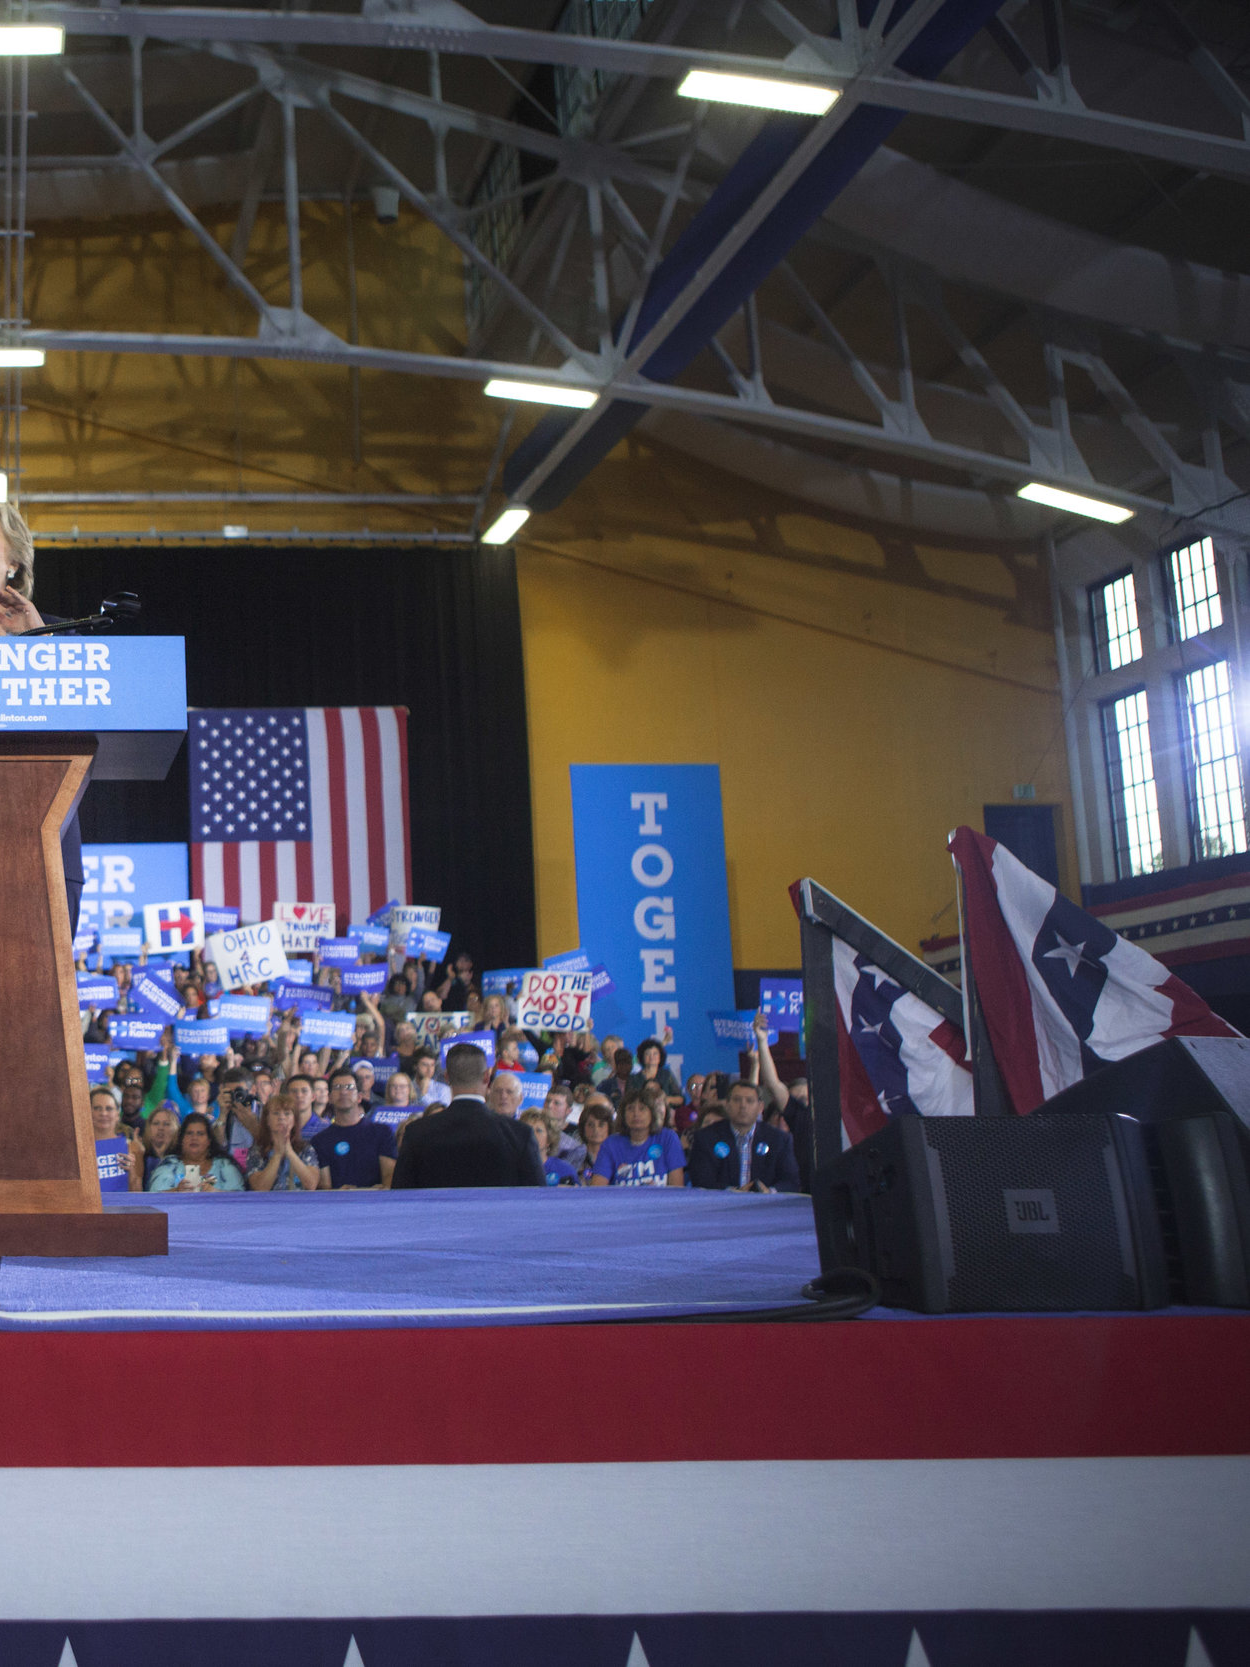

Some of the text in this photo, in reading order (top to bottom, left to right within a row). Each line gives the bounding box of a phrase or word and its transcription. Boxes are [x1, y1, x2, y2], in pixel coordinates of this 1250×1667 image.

[286, 922, 329, 932] TRUMPS
[223, 925, 271, 952] OHIO
[630, 793, 685, 1085] TOGET
[228, 957, 273, 985] HRC
[530, 974, 558, 993] DO
[559, 974, 591, 991] THE
[523, 993, 588, 1014] MOST
[523, 1011, 585, 1031] GOOD
[130, 1022, 163, 1031] Clinton
[129, 1030, 156, 1038] Kaine
[177, 1027, 227, 1036] STRONGER
[84, 1053, 108, 1062] inton
[86, 1062, 101, 1071] ine
[523, 1082, 549, 1090] NGER
[524, 1090, 549, 1099] THER
[375, 1110, 412, 1118] STRONG
[1014, 1200, 1050, 1221] JBL
